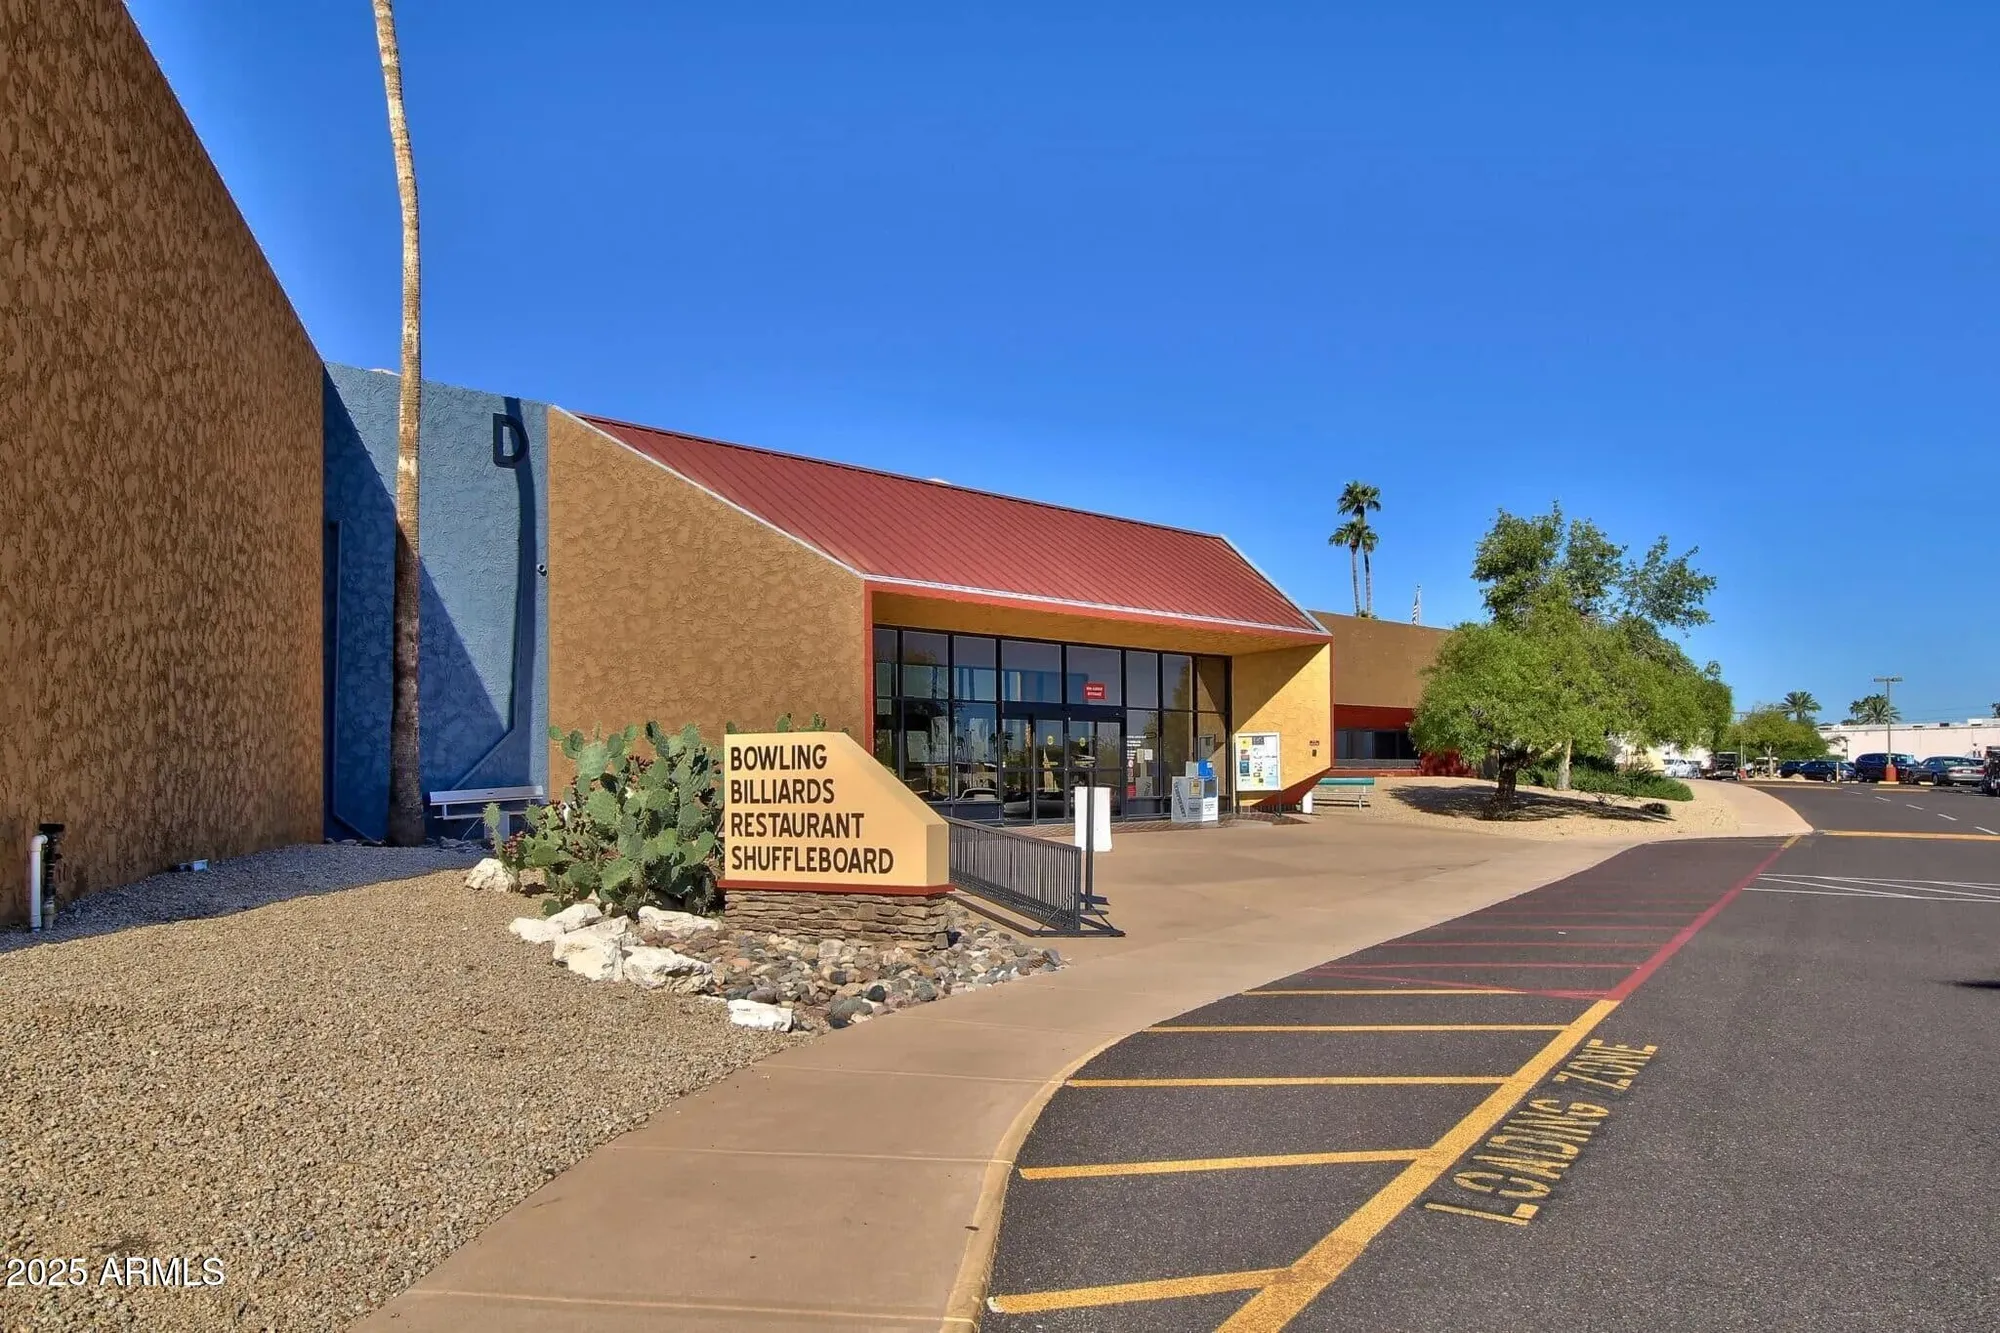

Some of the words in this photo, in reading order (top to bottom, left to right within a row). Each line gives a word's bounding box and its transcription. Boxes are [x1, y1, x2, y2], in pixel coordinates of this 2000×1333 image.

[493, 413, 530, 469] D
[730, 744, 828, 771] BOWLING
[730, 778, 835, 804] BILLIARDS
[731, 812, 865, 839] RESTAURANT
[731, 845, 894, 874] SHUFFLEBOARD
[1424, 1099, 1610, 1226] LOADING
[1552, 1038, 1658, 1091] ZONE
